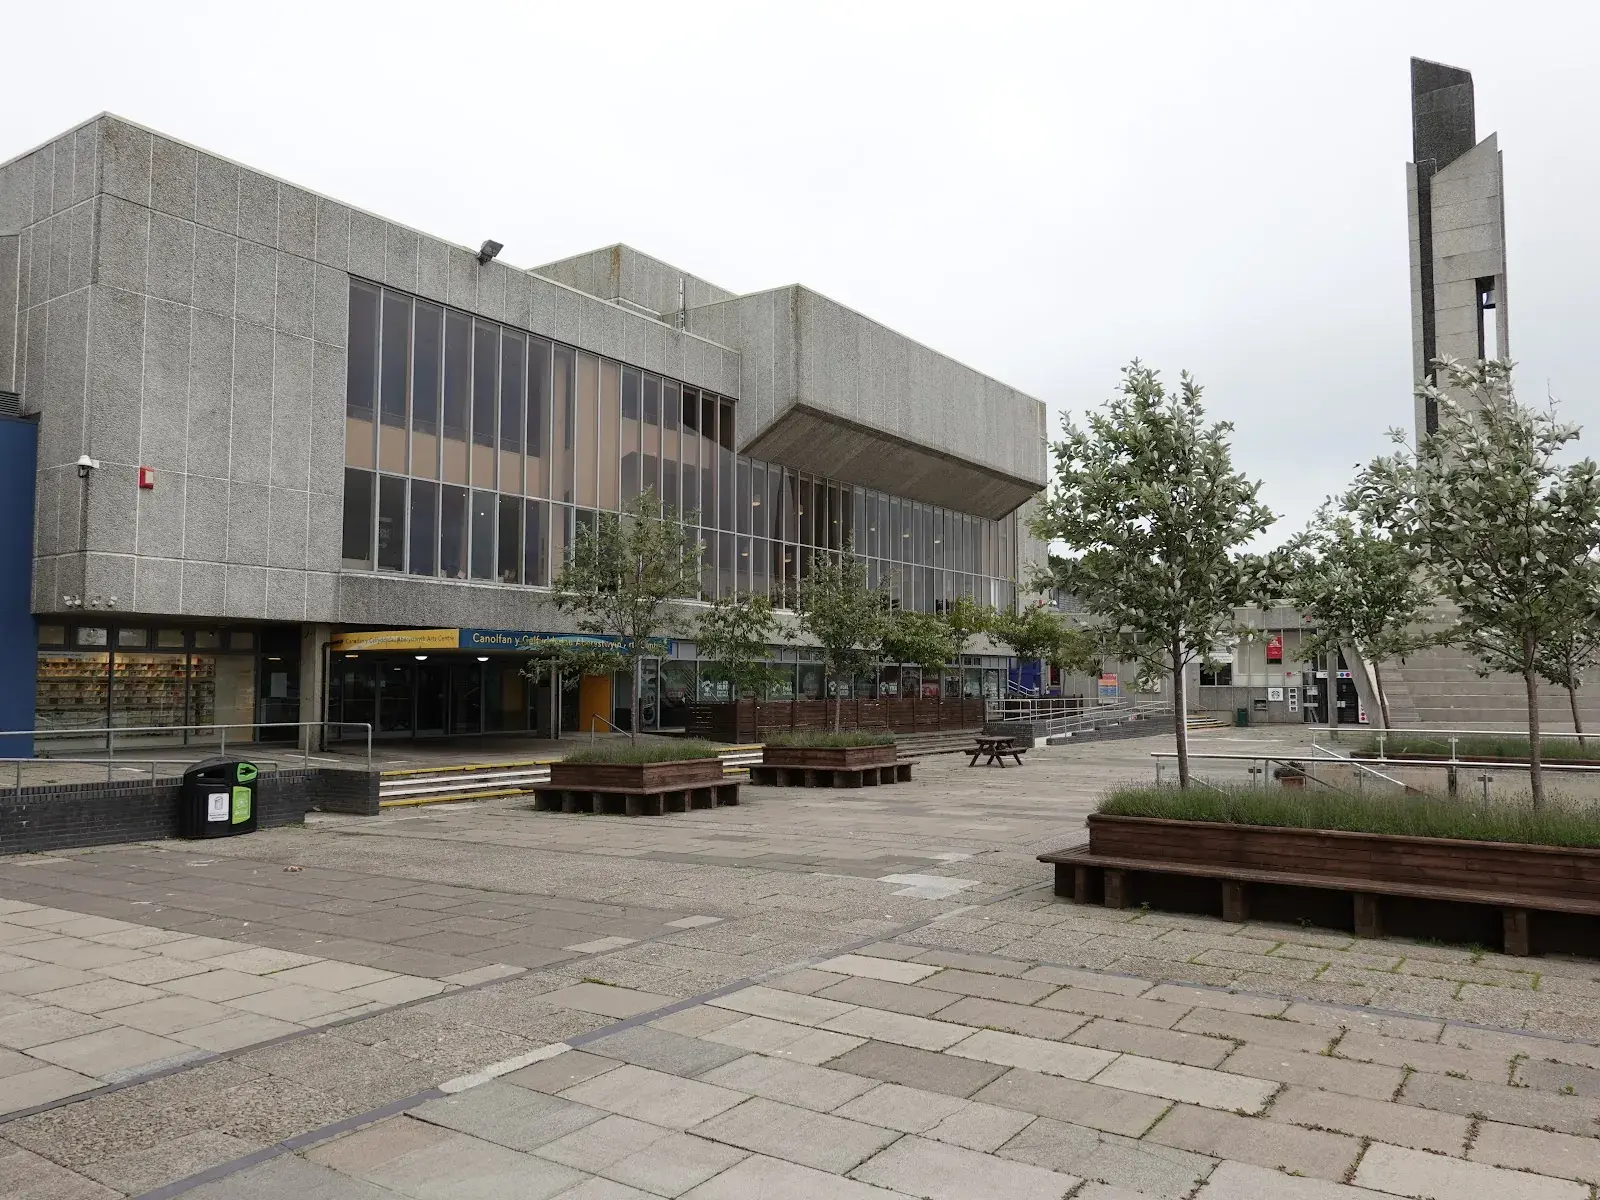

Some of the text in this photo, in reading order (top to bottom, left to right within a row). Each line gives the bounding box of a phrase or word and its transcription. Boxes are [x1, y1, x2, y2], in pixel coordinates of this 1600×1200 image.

[437, 634, 455, 642] Centre
[472, 633, 512, 644] Canolfan
[514, 637, 520, 647] y
